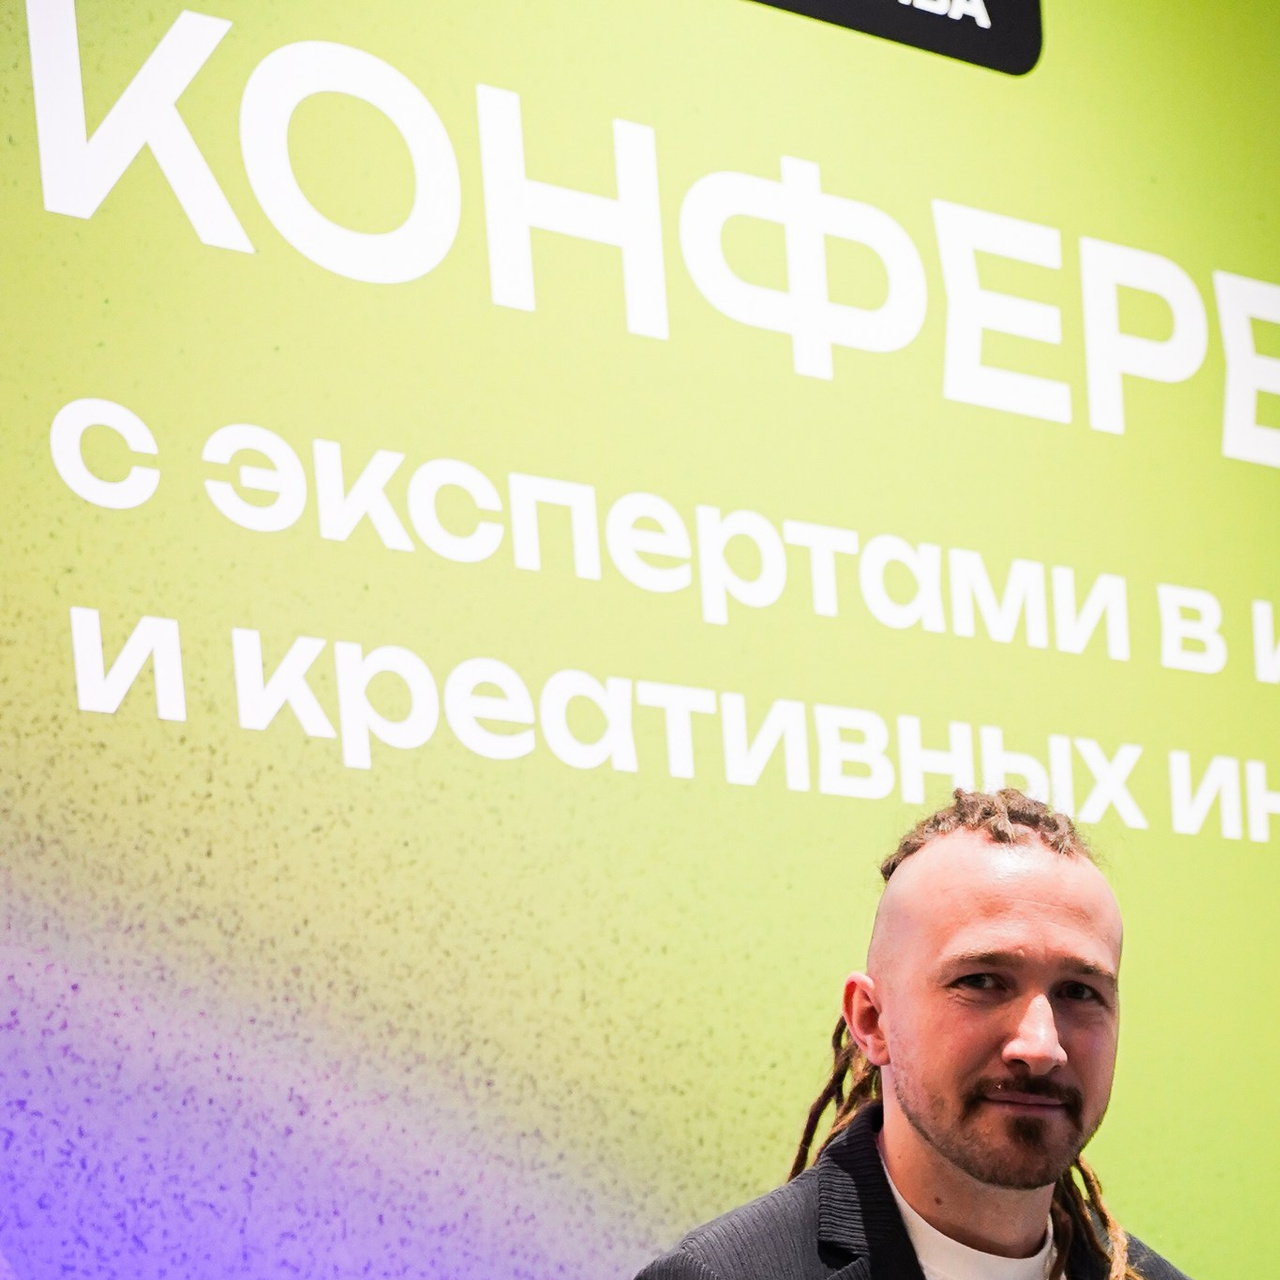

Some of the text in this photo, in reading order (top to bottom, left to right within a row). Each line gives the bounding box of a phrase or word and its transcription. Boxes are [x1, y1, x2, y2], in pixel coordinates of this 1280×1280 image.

[50, 398, 161, 509] с
[202, 423, 1132, 662] экспертами
[1156, 583, 1227, 675] в
[70, 606, 187, 721] и
[231, 626, 1149, 830] креативных
